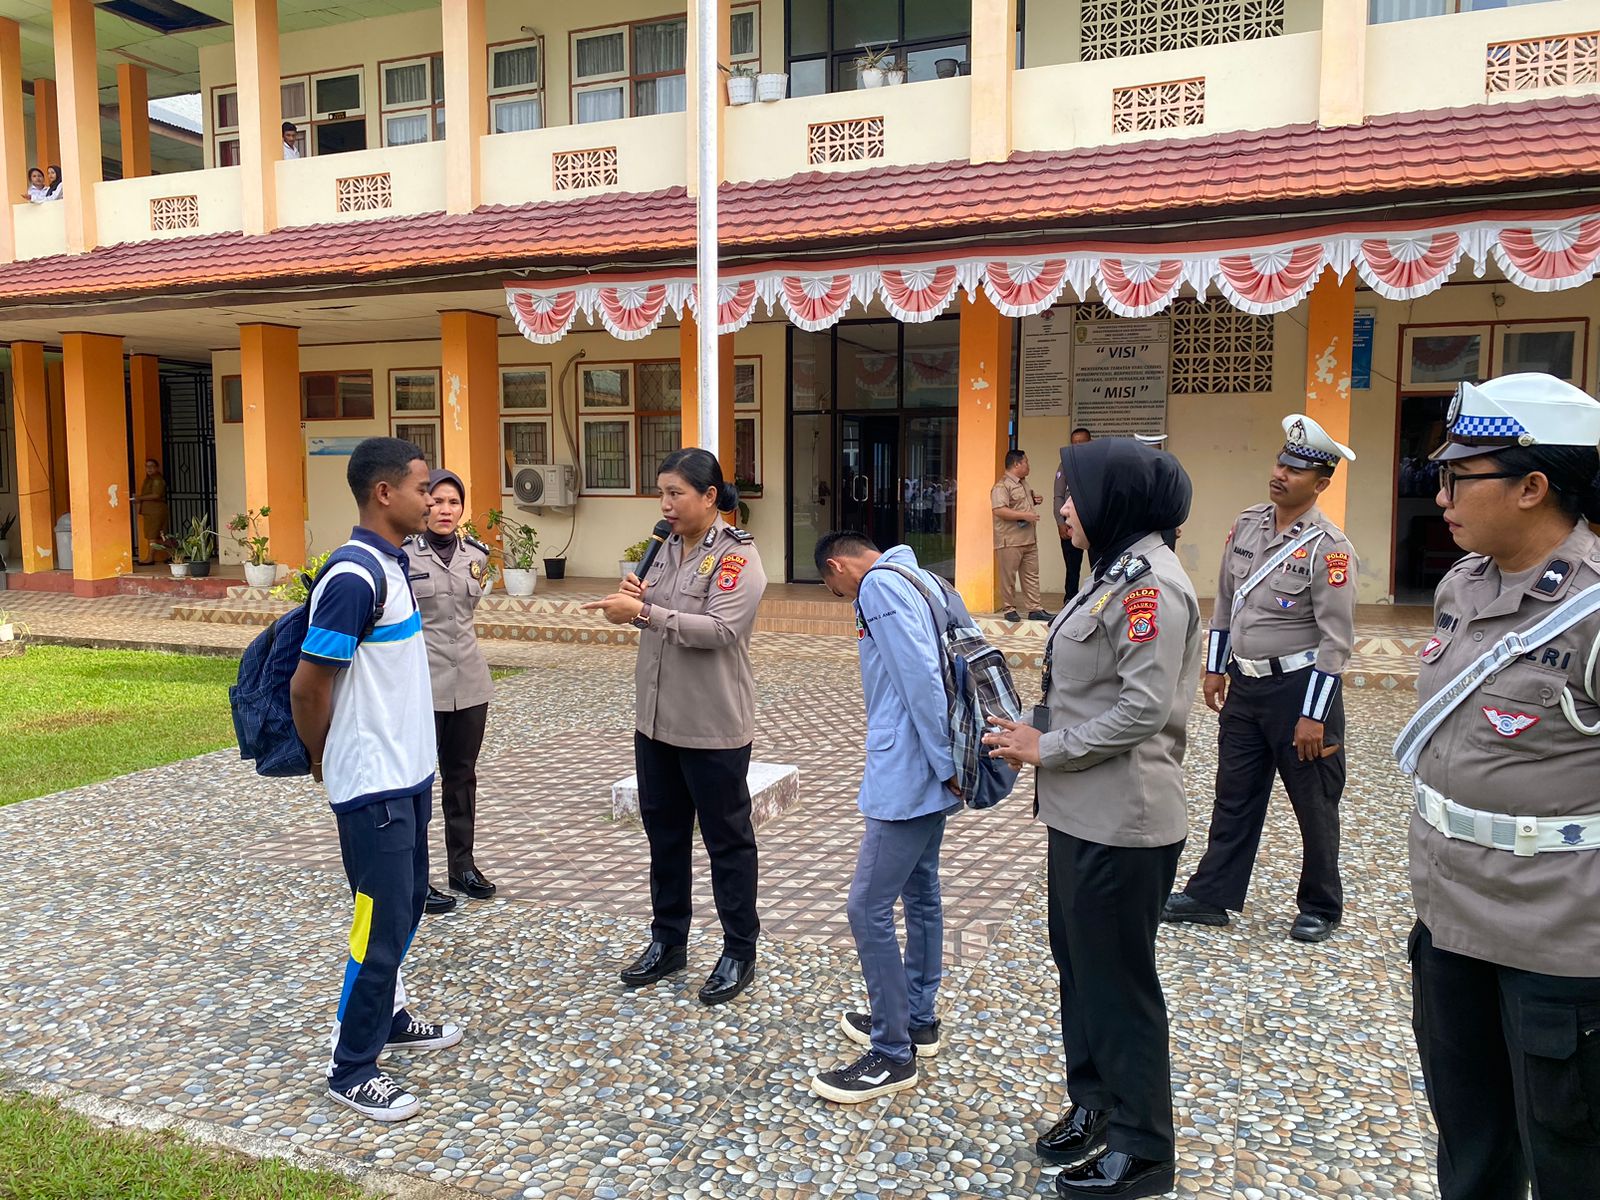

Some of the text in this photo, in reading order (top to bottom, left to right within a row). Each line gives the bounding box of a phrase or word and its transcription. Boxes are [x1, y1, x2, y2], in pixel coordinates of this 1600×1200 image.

[1109, 346, 1136, 358] VISI
[1104, 386, 1136, 399] MISI
[723, 556, 744, 564] POLDA
[1278, 562, 1310, 576] POLRI
